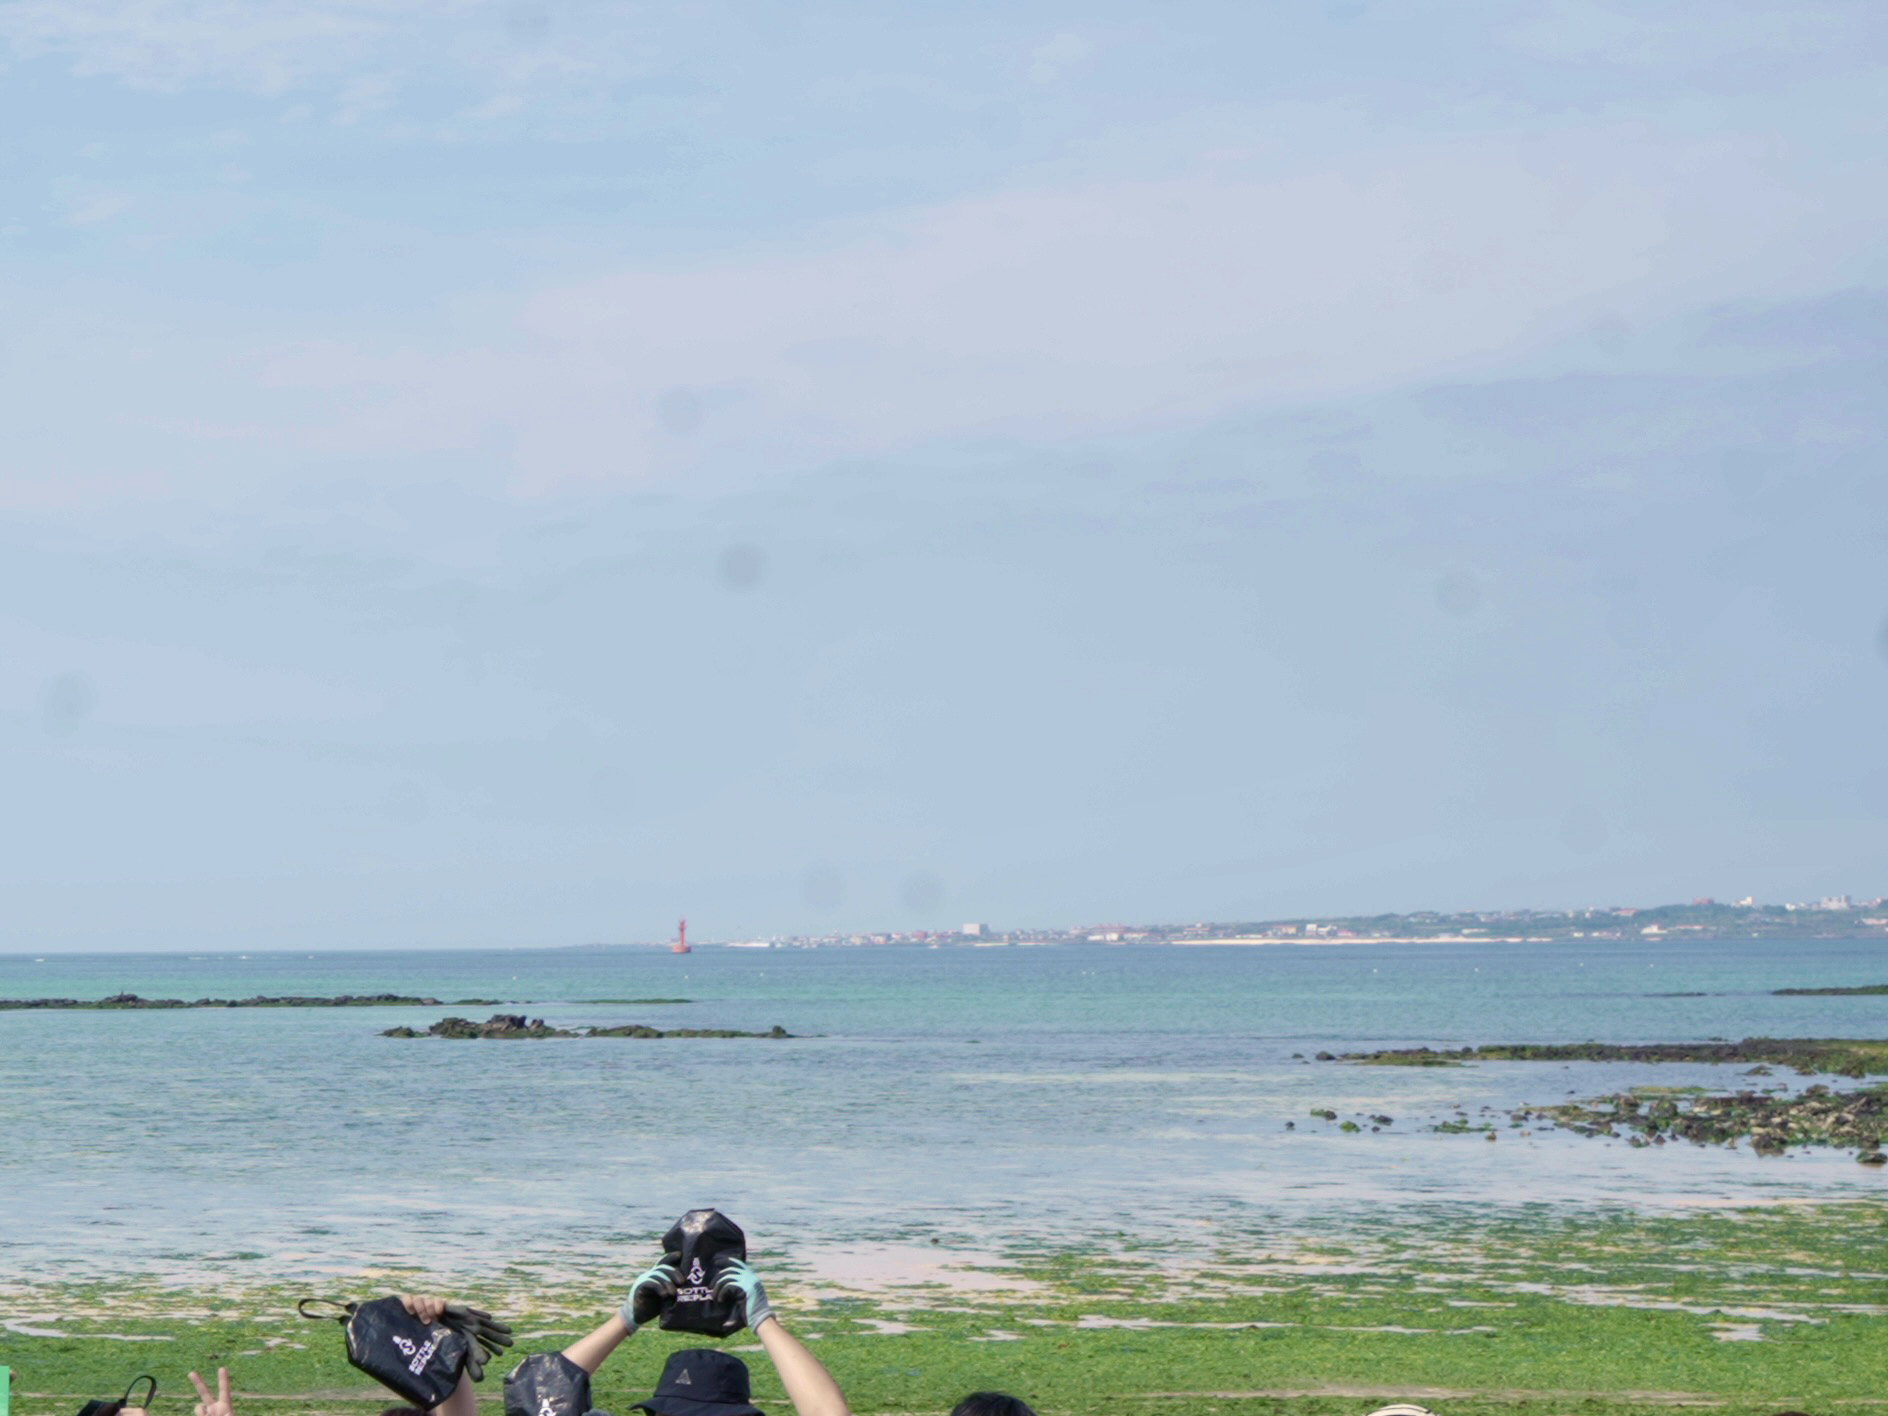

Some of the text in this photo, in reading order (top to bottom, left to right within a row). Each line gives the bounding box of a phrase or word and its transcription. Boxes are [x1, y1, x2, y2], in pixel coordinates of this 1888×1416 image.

[676, 1287, 713, 1295] BOTTL
[677, 1294, 713, 1302] RE:PLA
[409, 1340, 432, 1372] BOTTLE
